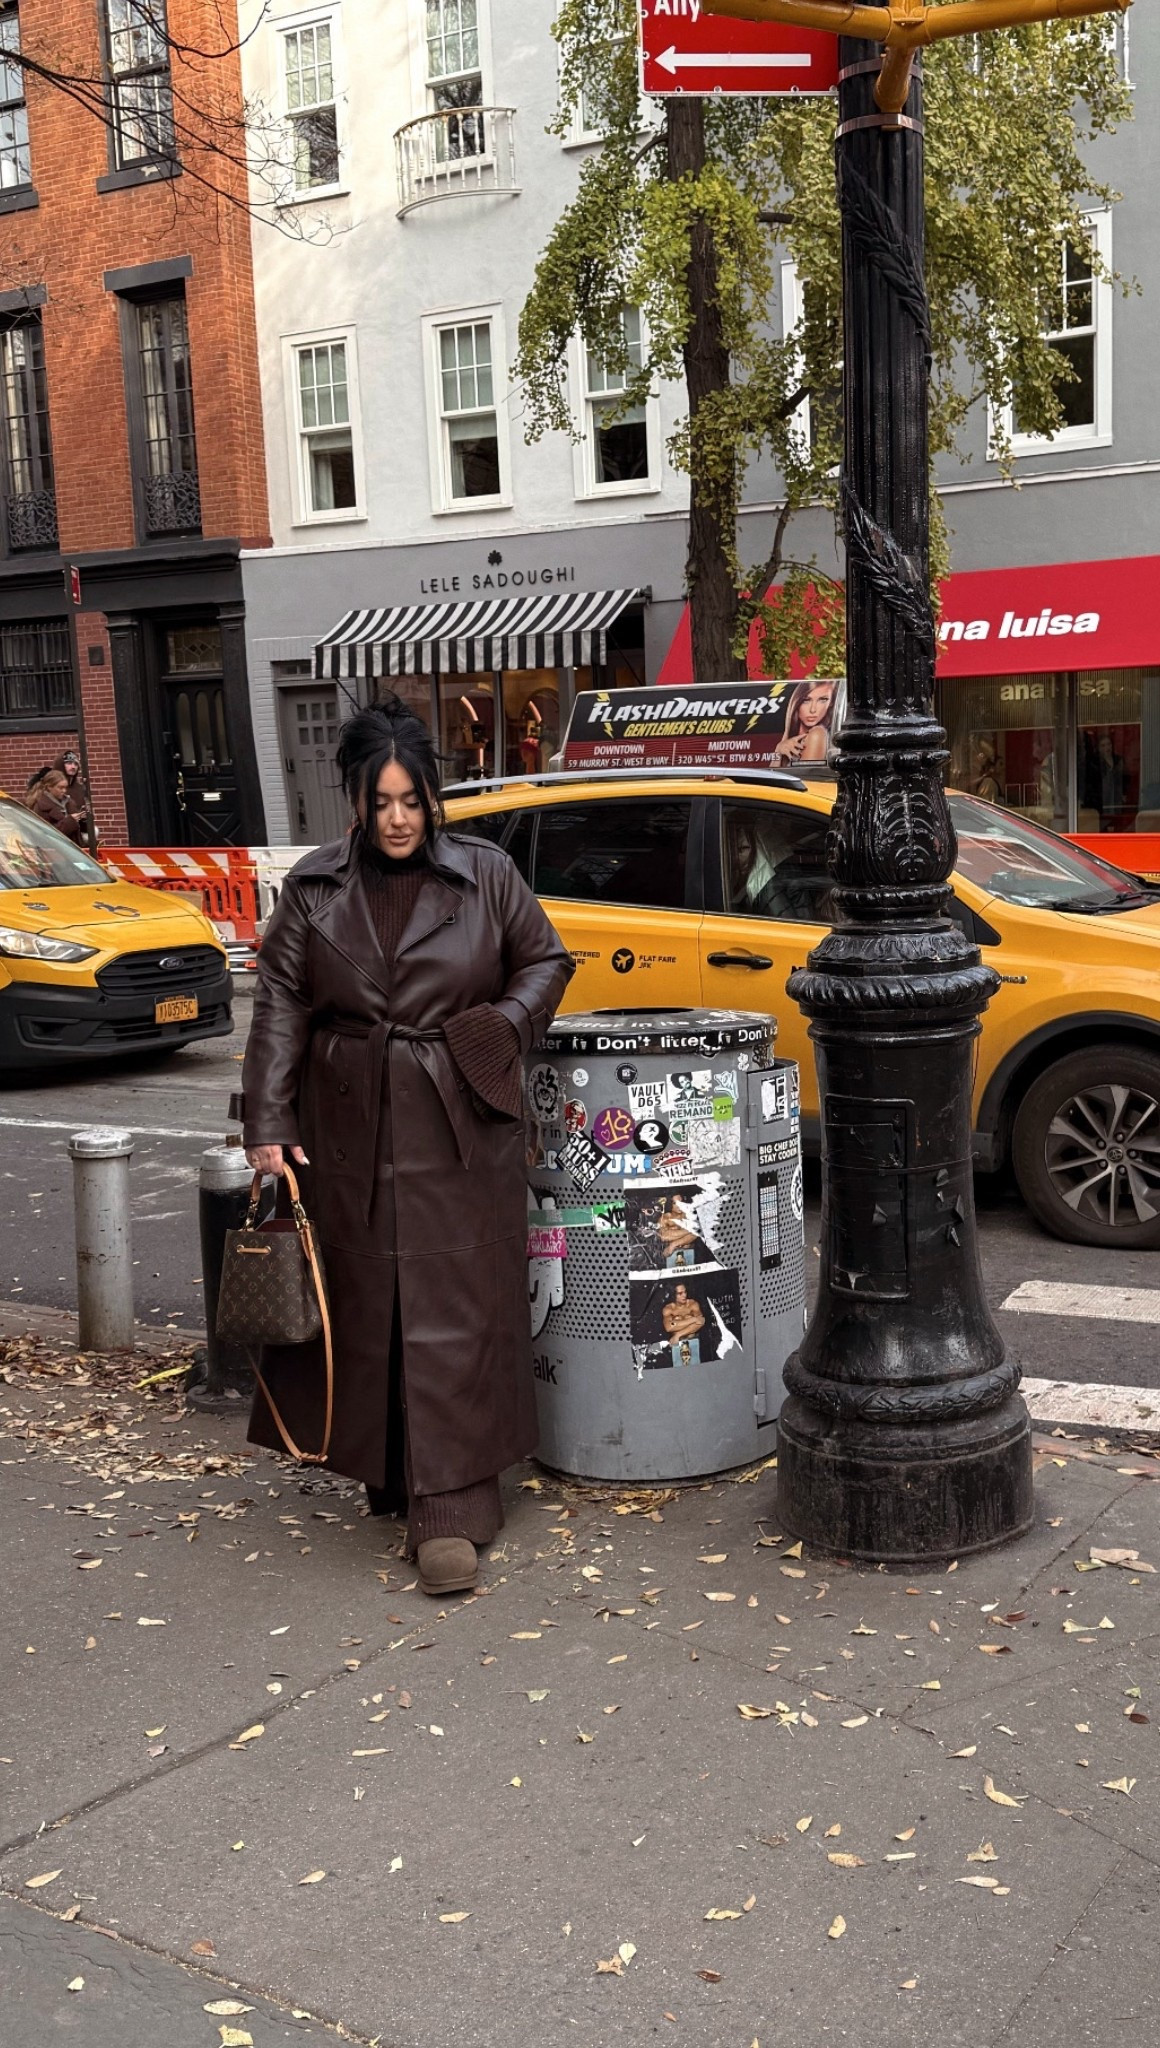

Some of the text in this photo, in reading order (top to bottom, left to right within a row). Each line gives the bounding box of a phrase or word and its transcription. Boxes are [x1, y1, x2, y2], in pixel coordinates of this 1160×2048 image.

[420, 566, 575, 594] LELE SADOUGHI
[998, 608, 1101, 639] luisa
[1000, 682, 1045, 701] ana
[623, 718, 737, 738] GENTLEMEN'S CLUBS
[593, 744, 645, 756] DOWNTOWN
[708, 740, 751, 752] MIDTOWN
[567, 759, 577, 768] 59
[579, 758, 609, 768] MURRAY
[624, 757, 644, 767] WEST
[678, 755, 693, 765] 320
[730, 753, 746, 763] BTW
[761, 752, 781, 762] AVES
[638, 955, 656, 963] FLAT
[596, 1035, 652, 1050] Don't
[660, 1034, 707, 1048] litter
[738, 1026, 768, 1042] Don't
[631, 1083, 665, 1098] VAULT
[638, 1096, 662, 1108] D65
[669, 1106, 713, 1119] REMAND
[759, 1144, 773, 1155] BIG
[774, 1141, 788, 1152] CHEF
[559, 1142, 600, 1181] MUSS
[759, 1152, 777, 1165] STAY
